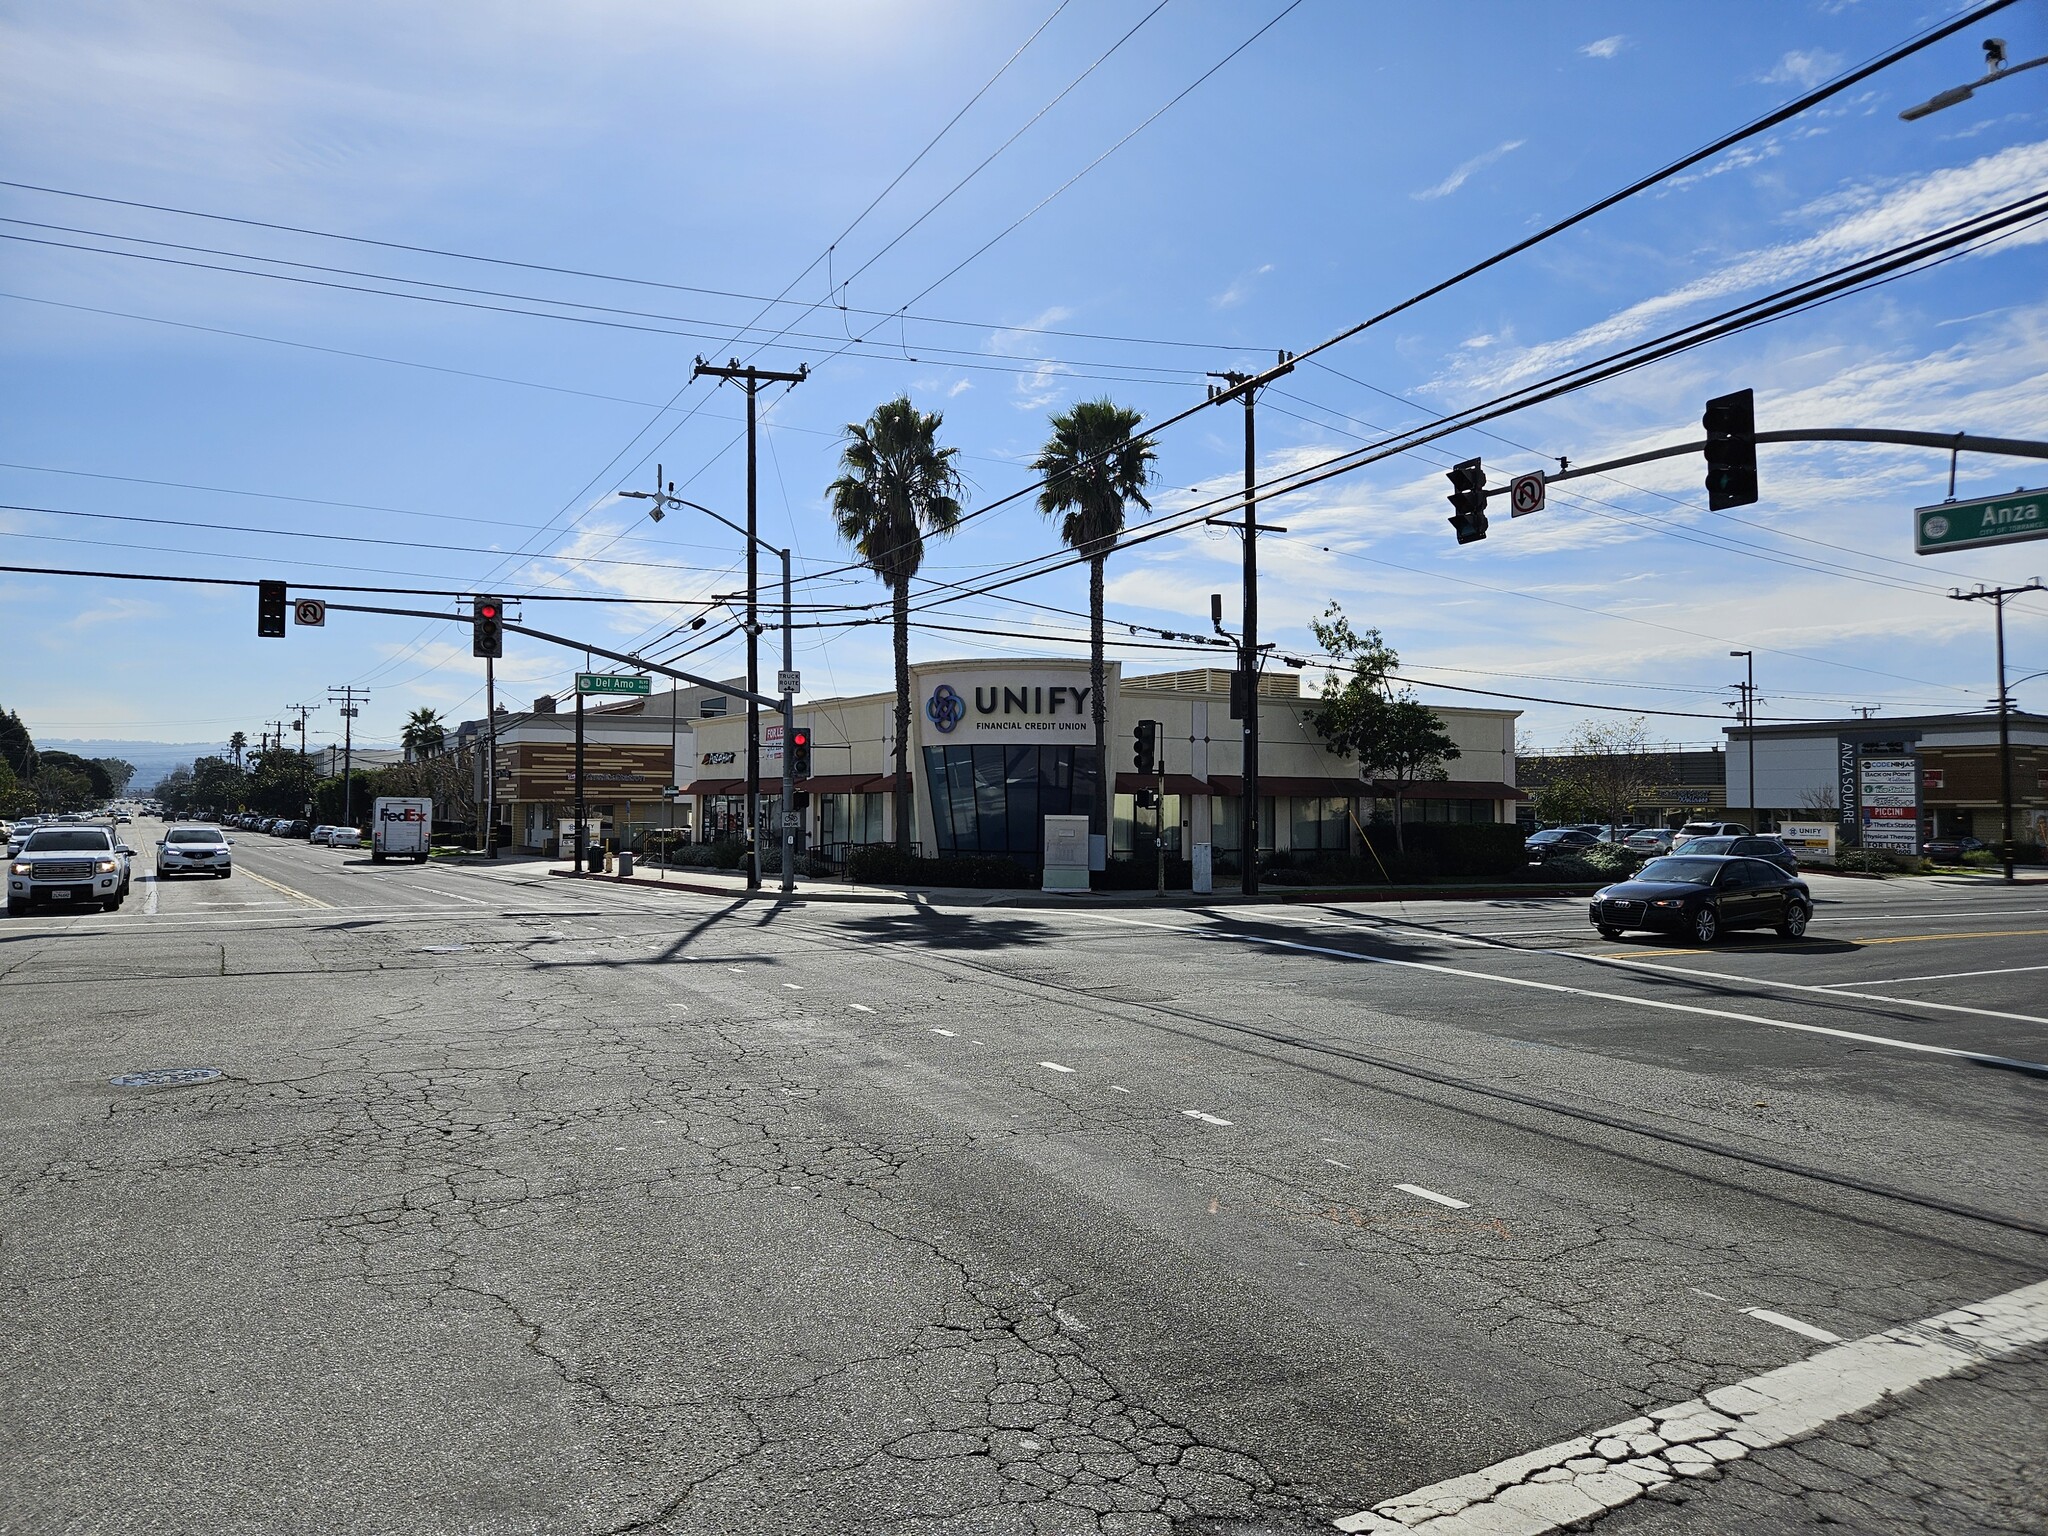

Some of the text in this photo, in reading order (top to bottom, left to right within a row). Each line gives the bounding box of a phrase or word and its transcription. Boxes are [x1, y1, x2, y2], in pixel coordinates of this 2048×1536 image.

[1981, 503, 2039, 527] Anza
[2009, 521, 2045, 531] TORRANCE
[595, 677, 634, 689] Del Amo
[975, 686, 1091, 715] UNIFY
[976, 721, 1087, 730] FINANCIAL CREDIT UNION
[1842, 742, 1855, 824] ANZA SQUARE
[380, 808, 427, 822] FedEx
[1874, 807, 1903, 816] PICCINI
